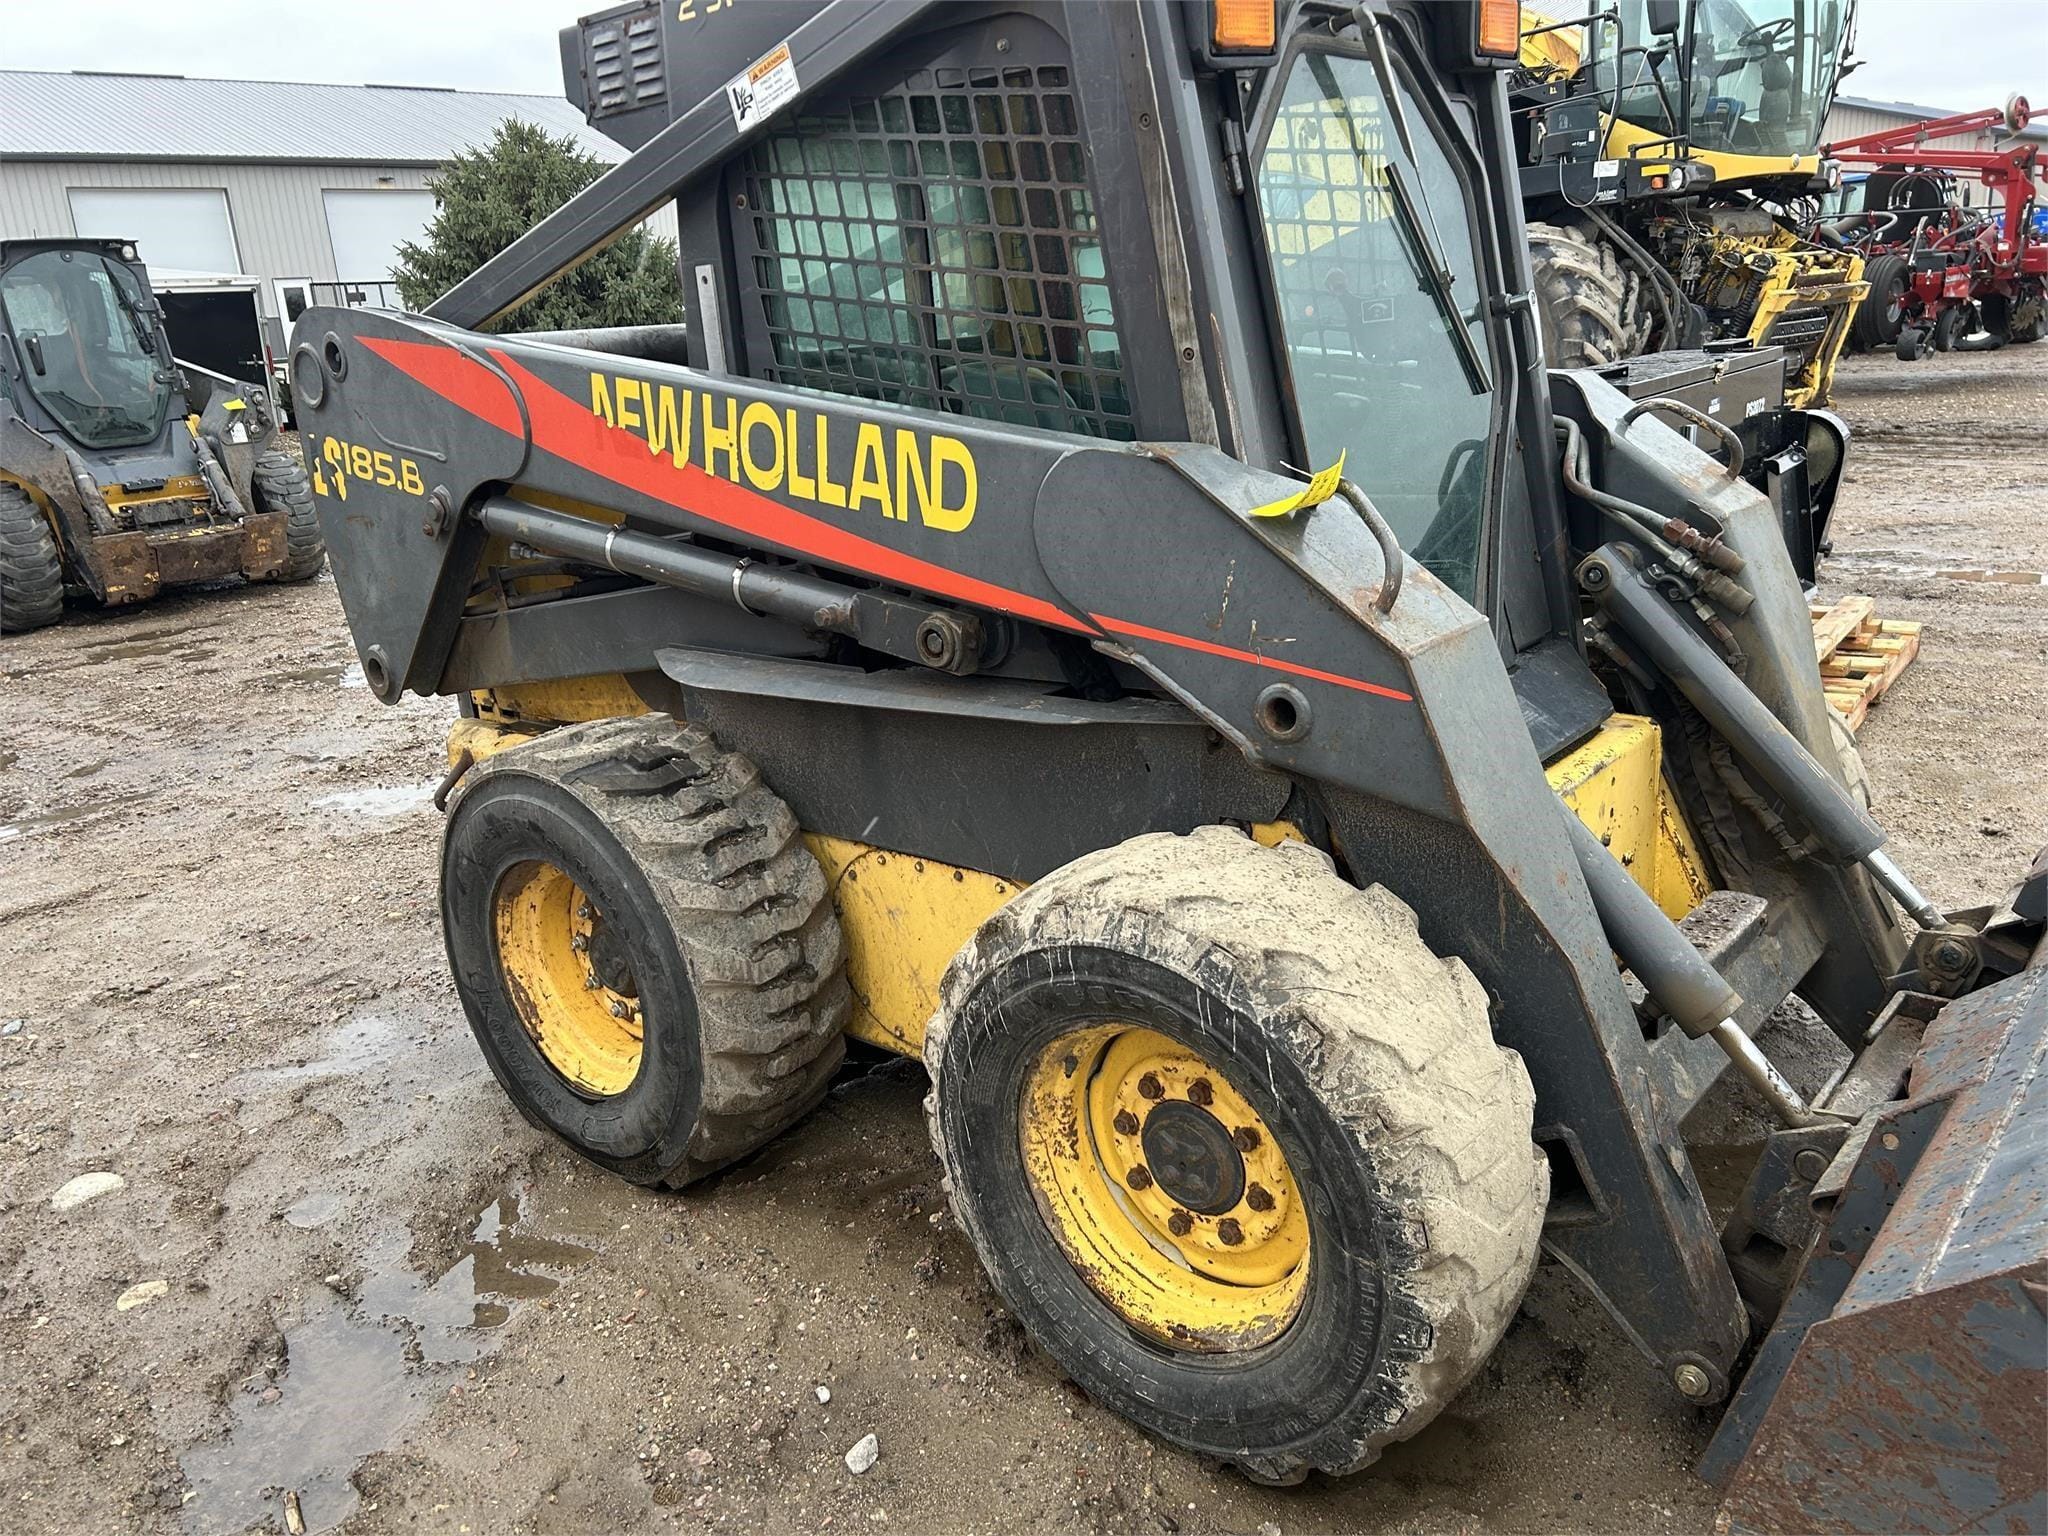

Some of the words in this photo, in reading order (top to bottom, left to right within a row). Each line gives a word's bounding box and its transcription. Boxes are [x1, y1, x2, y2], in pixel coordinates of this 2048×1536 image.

[757, 49, 786, 76] WARNING
[591, 372, 692, 470] NEW
[702, 393, 978, 533] HOLLAND
